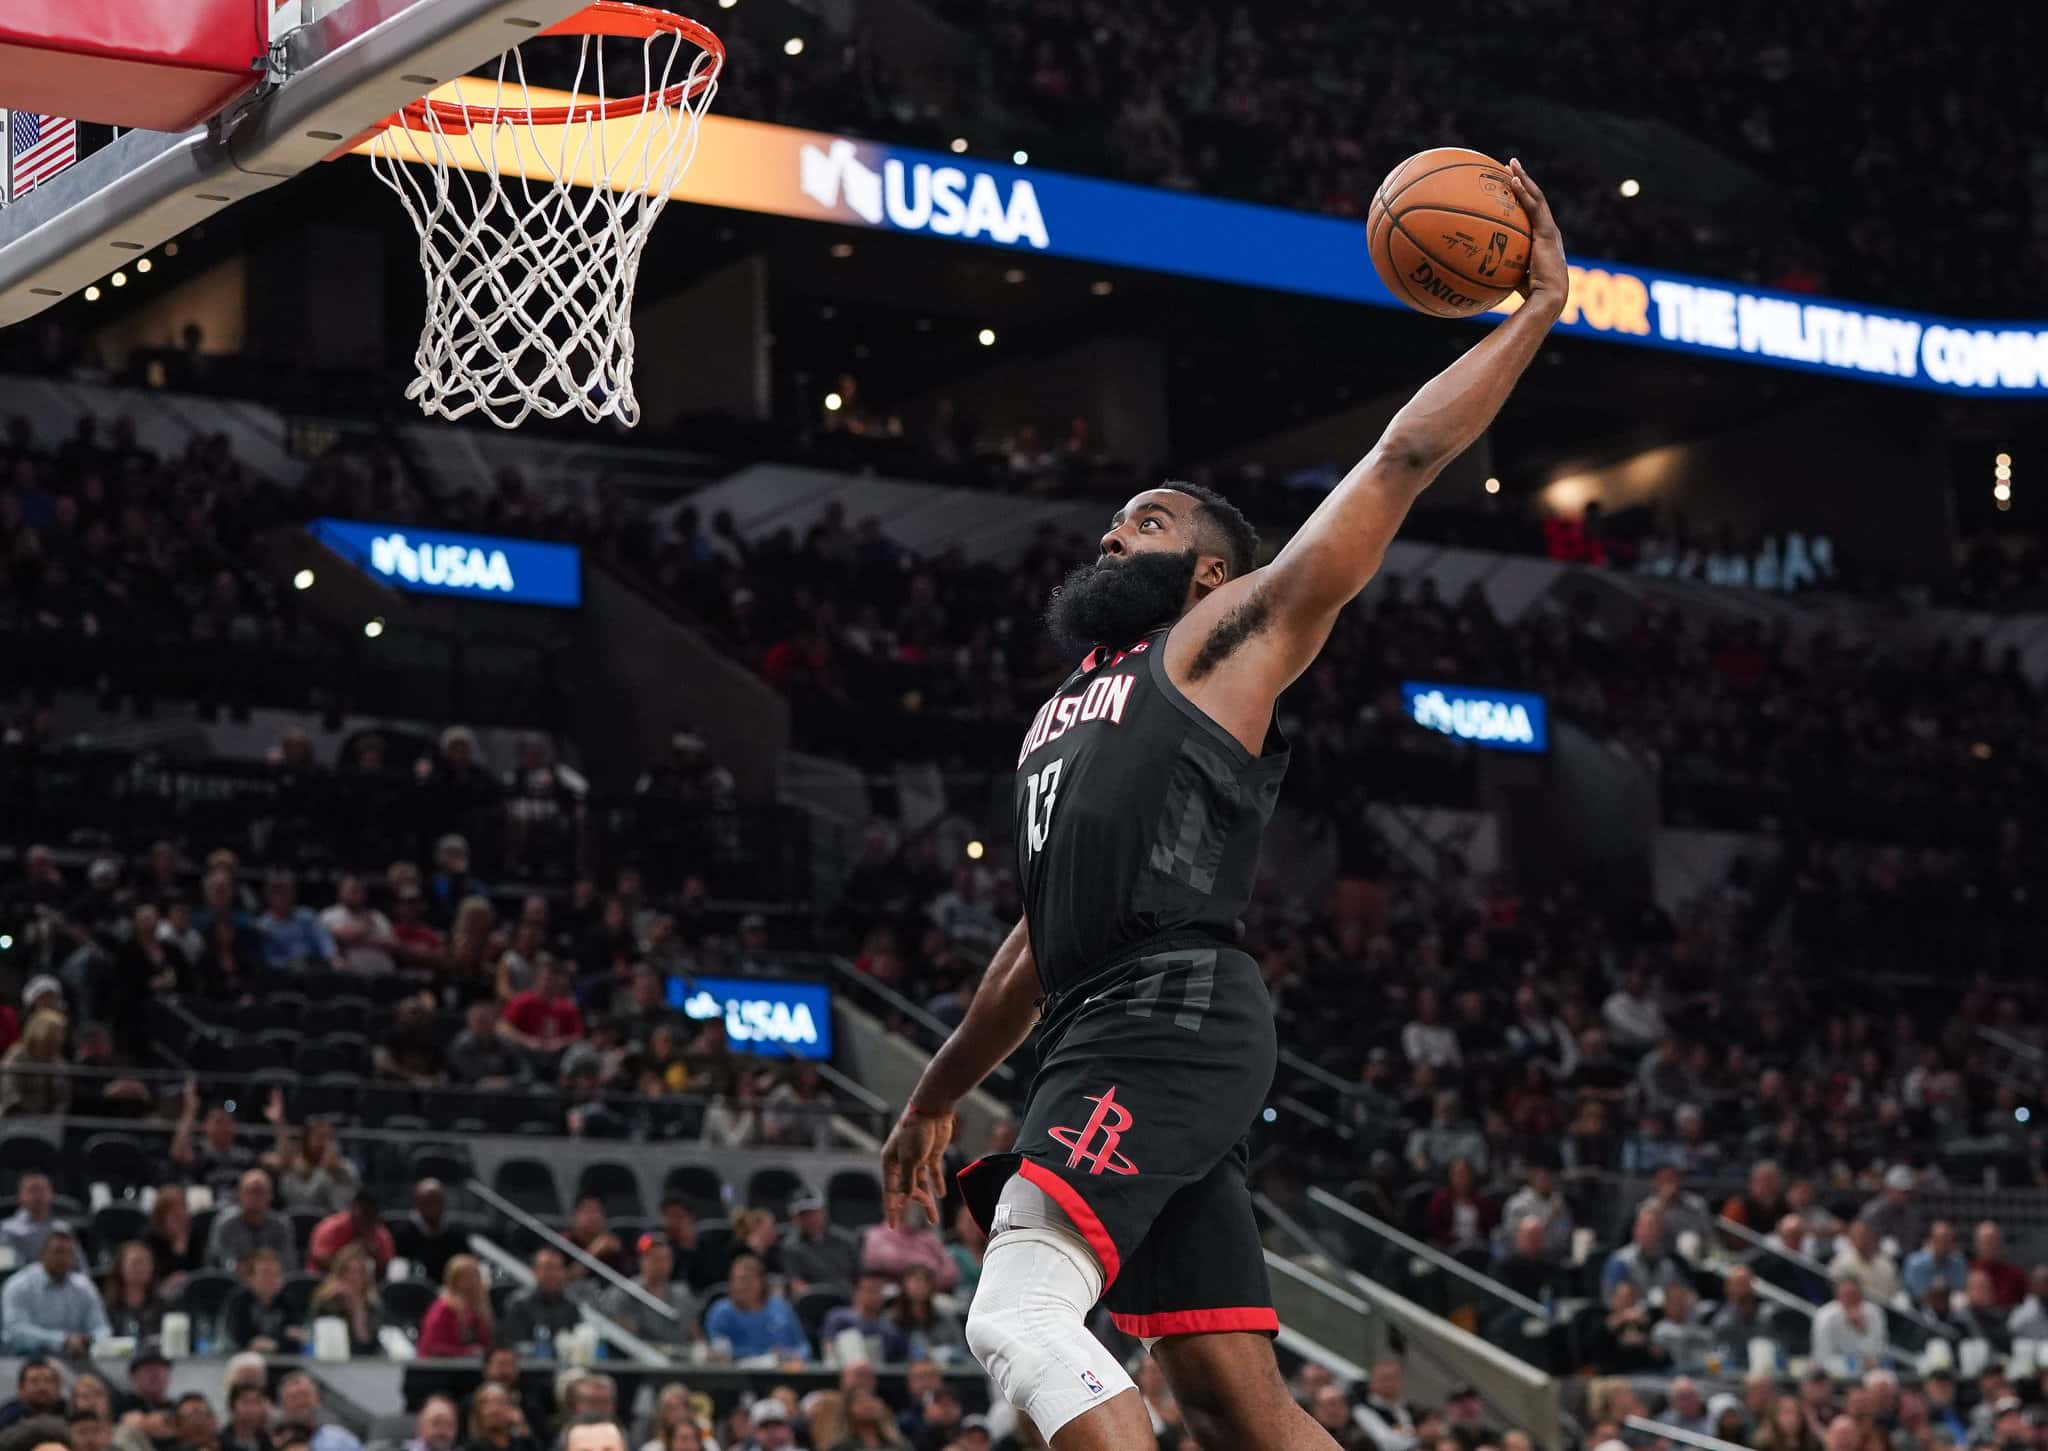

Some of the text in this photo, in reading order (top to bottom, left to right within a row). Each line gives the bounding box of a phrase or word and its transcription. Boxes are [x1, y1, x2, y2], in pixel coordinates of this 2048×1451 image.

[884, 159, 1050, 249] USAA
[1558, 264, 1651, 336] FOR
[1650, 280, 1738, 350] THE
[1737, 294, 1922, 378] MILITARY
[418, 542, 514, 592] USAA
[1017, 674, 1136, 770] OUSTON
[1453, 698, 1533, 743] USAA
[1027, 757, 1063, 862] 13
[725, 998, 817, 1044] USAA
